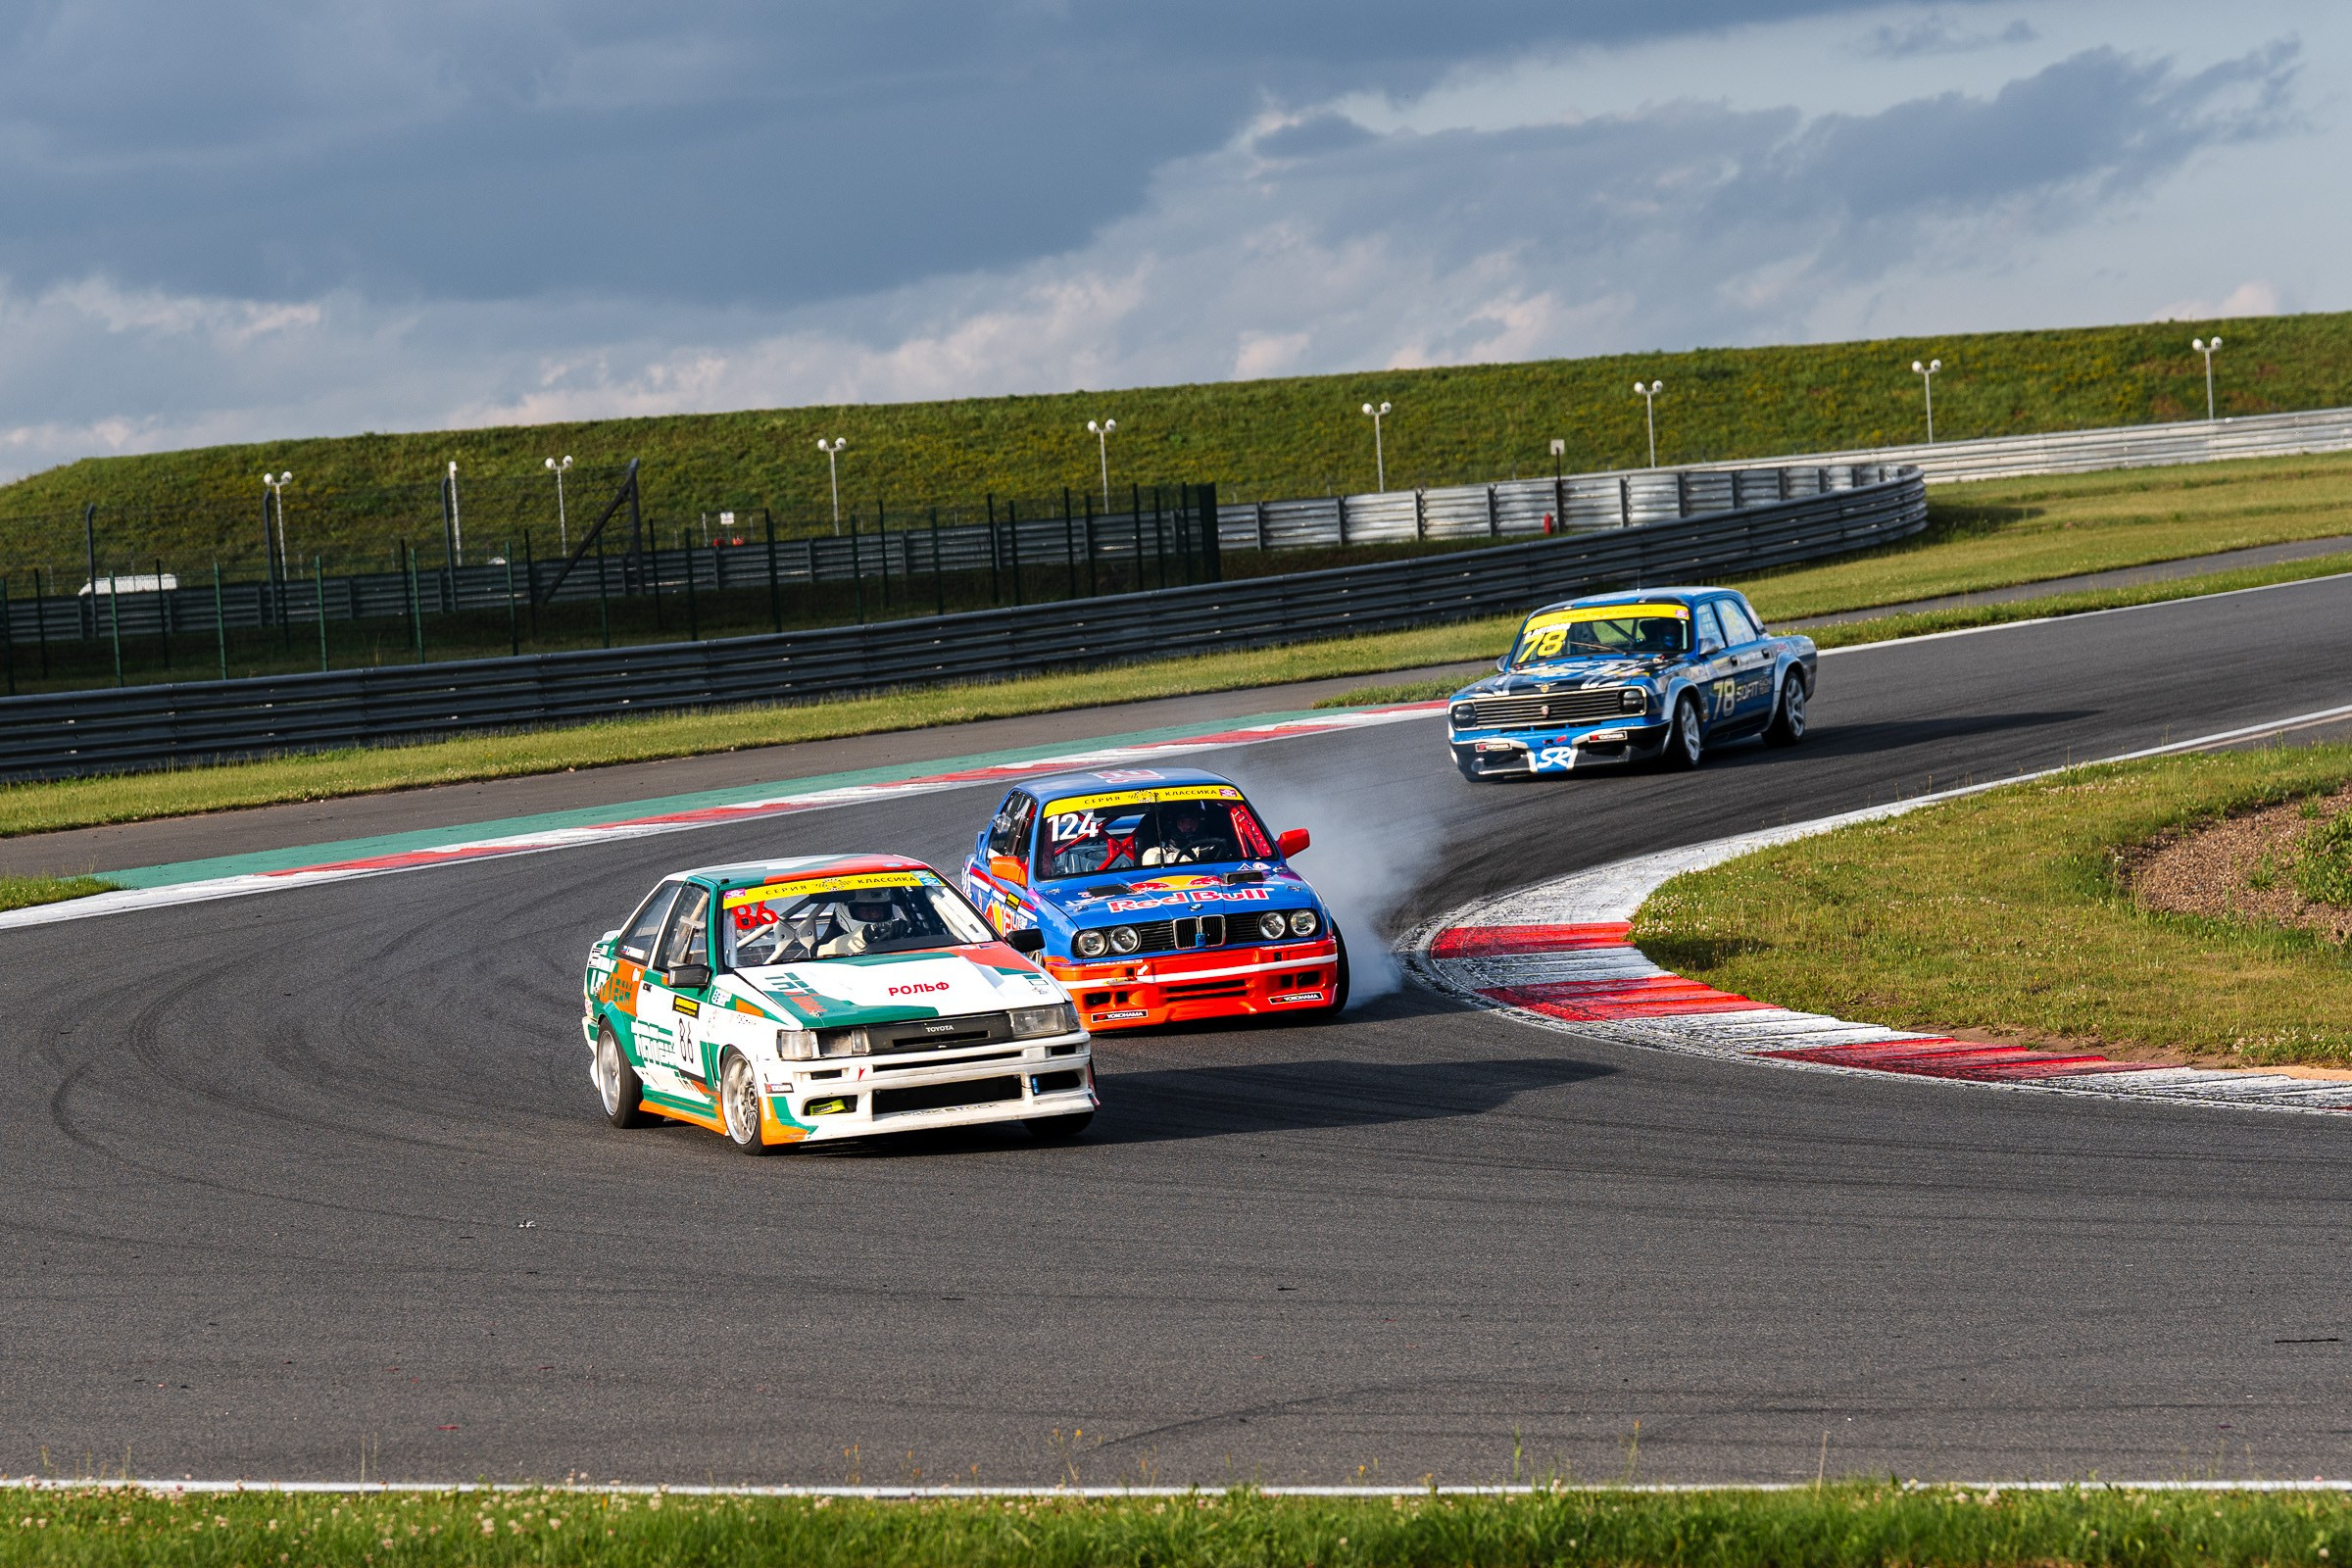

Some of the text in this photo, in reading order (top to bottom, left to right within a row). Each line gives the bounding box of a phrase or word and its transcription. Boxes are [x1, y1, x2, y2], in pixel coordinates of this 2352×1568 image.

[1518, 629, 1568, 663] 78
[1713, 677, 1736, 720] 78
[1084, 795, 1120, 805] СЕРИЯ
[1047, 812, 1100, 842] 124
[764, 884, 807, 896] СЕРИЯ
[1107, 891, 1187, 913] Red
[1191, 887, 1271, 903] Bull
[730, 900, 778, 930] 86
[888, 981, 950, 997] РОЛЬФ
[1284, 993, 1319, 1002] YOKOHAMA
[1106, 1010, 1144, 1019] YOKOHAMA
[925, 1024, 955, 1033] TOYOTA
[678, 1017, 694, 1064] 86
